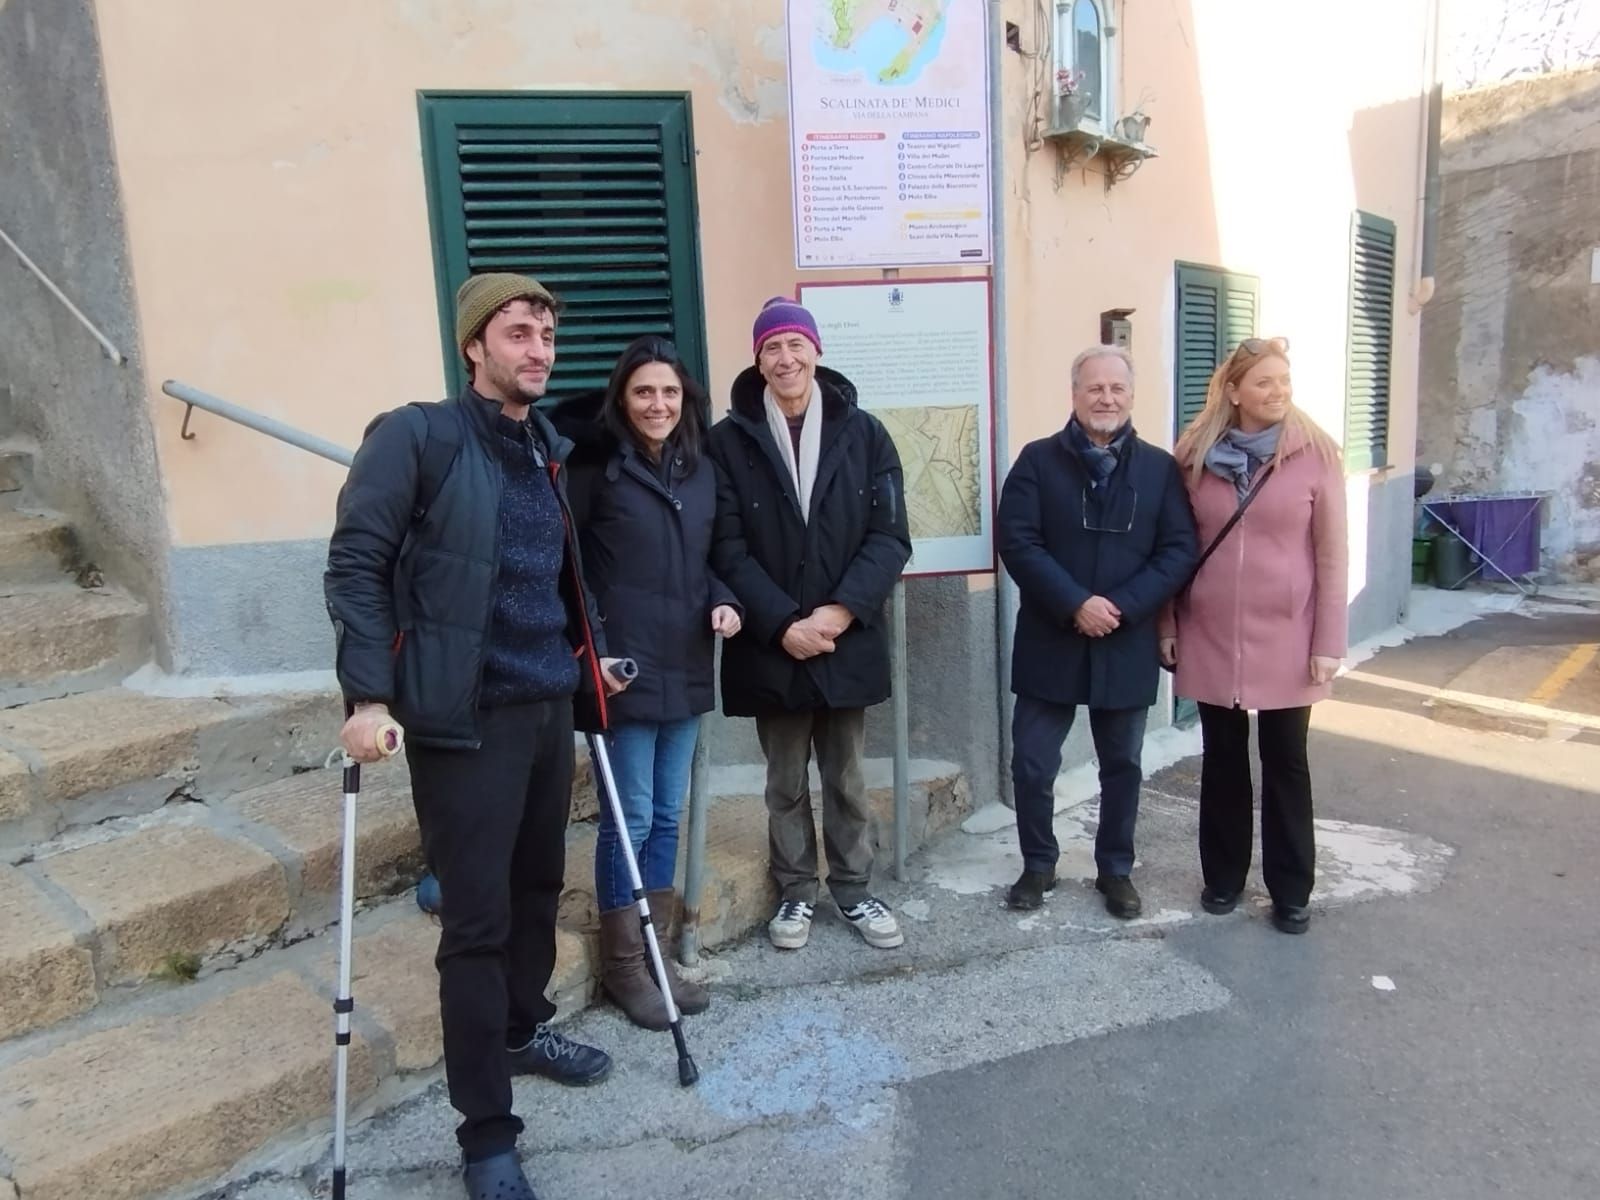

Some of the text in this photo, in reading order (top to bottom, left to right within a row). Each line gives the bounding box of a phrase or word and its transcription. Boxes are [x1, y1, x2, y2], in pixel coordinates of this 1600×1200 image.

[820, 97, 888, 109] SCALINATA
[915, 97, 960, 108] MEDICI
[892, 111, 929, 119] CAMPANA
